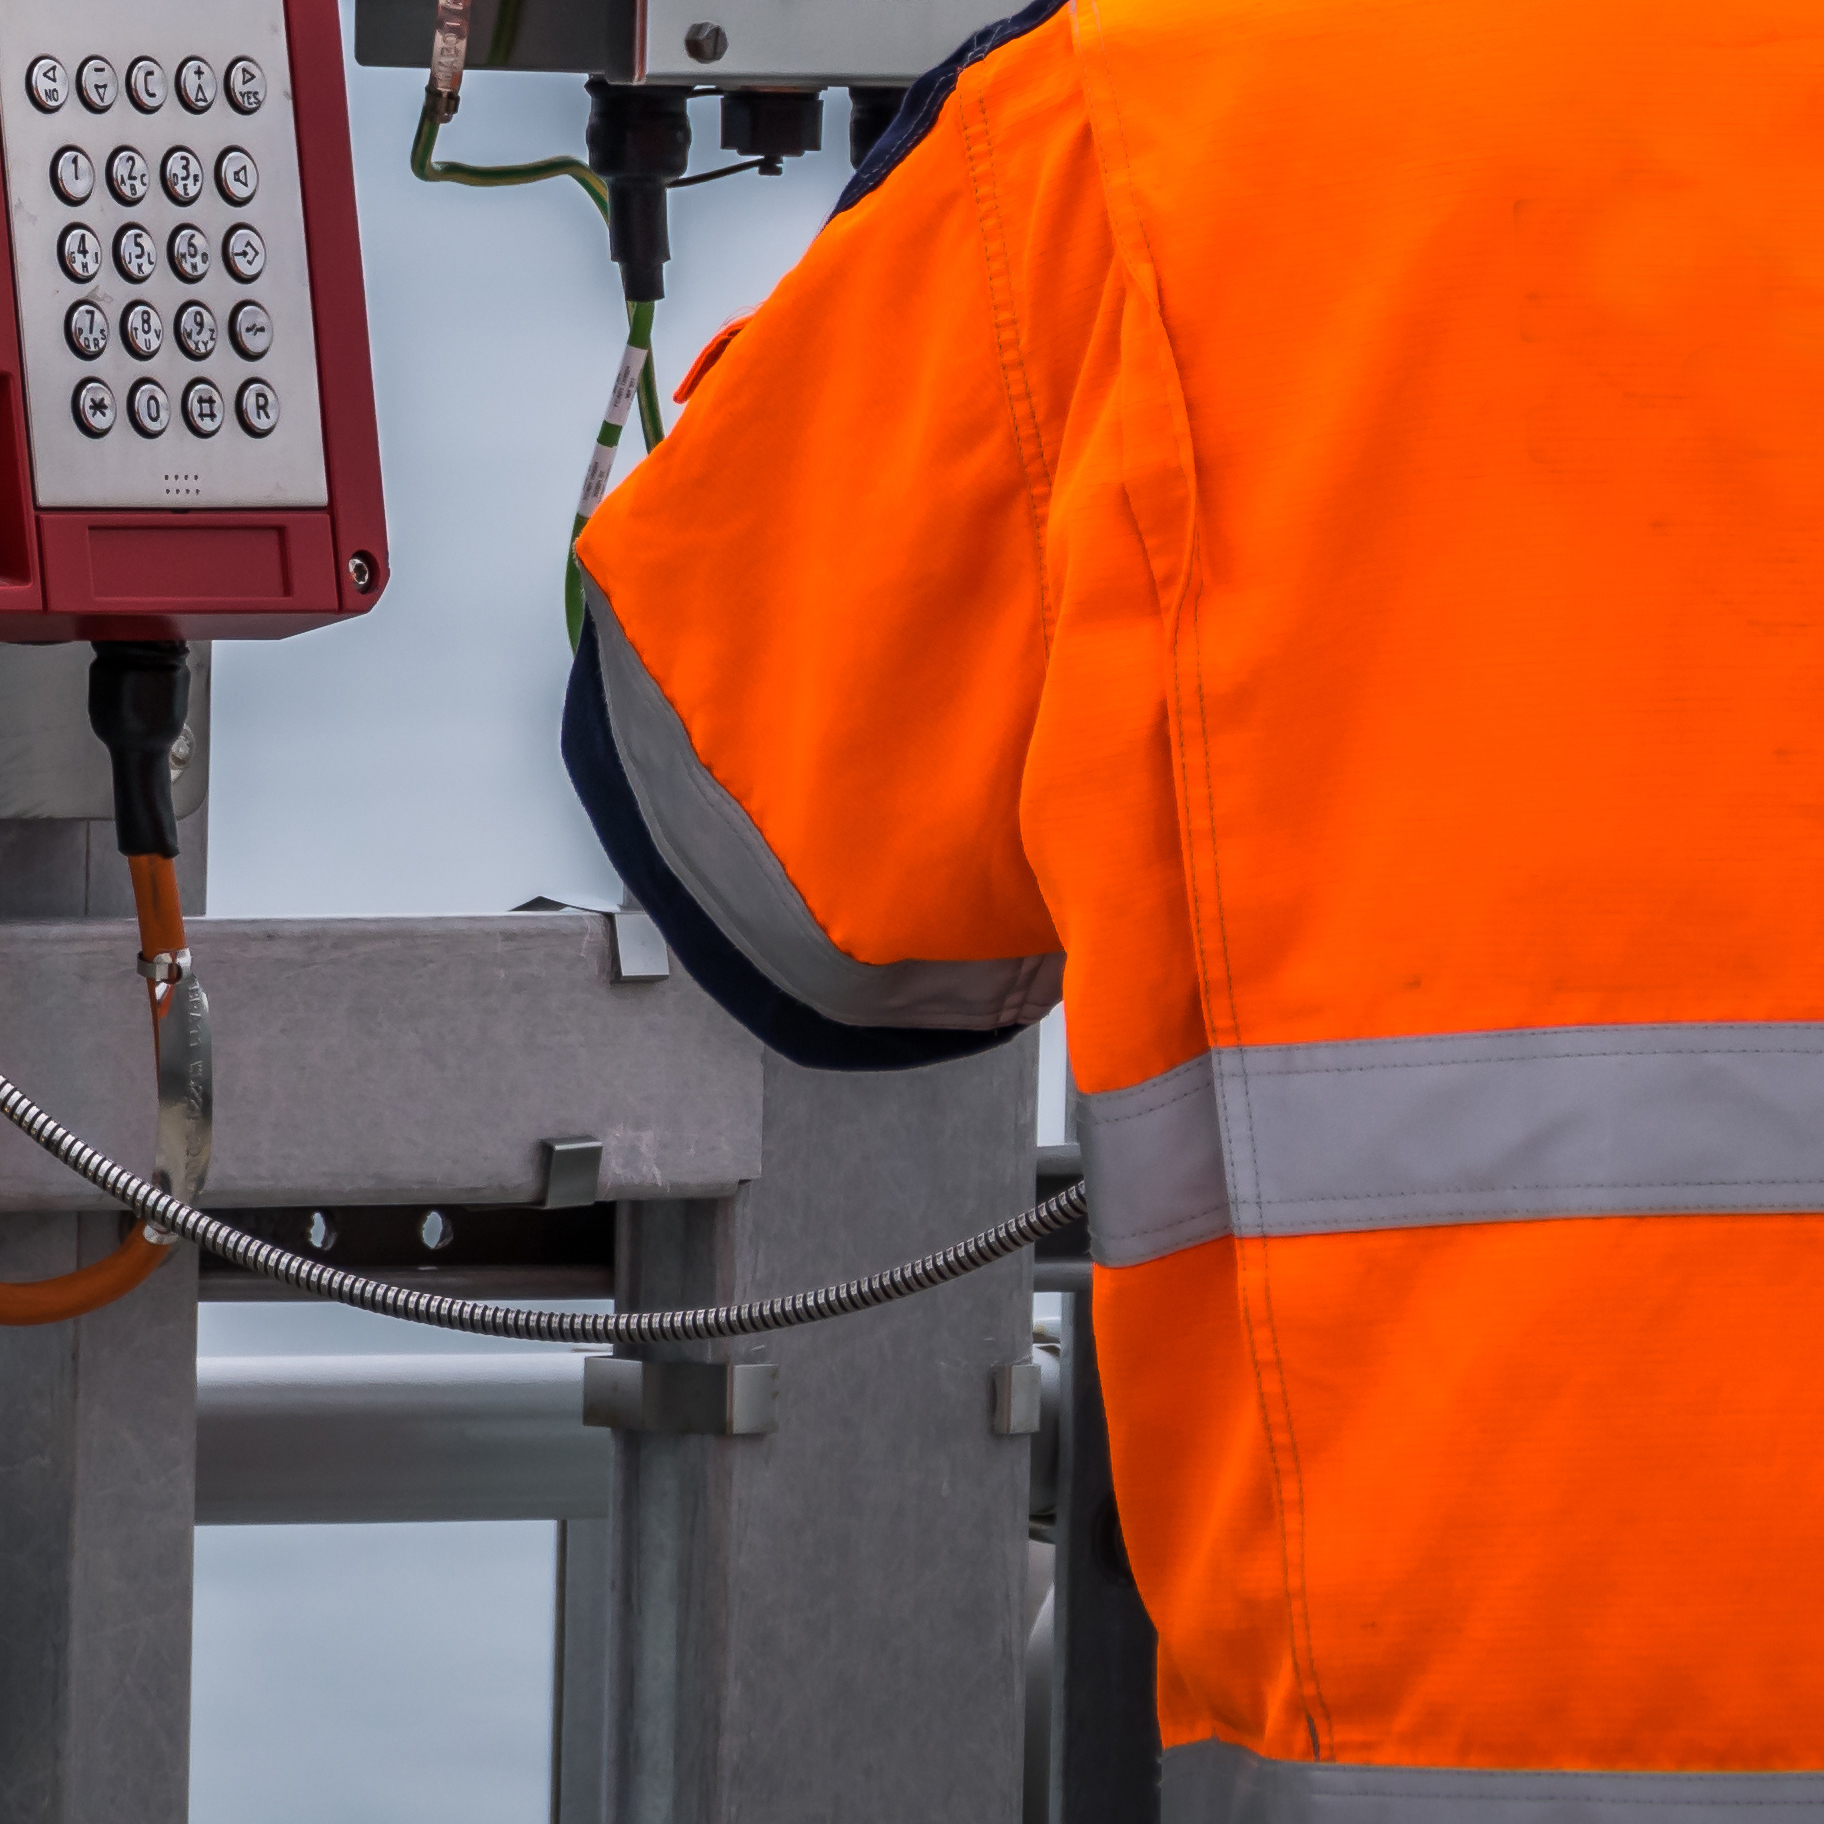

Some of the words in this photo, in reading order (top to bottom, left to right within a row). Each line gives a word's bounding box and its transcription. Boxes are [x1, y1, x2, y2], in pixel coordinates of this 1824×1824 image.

[44, 88, 59, 103] NO
[239, 90, 260, 106] YES
[71, 154, 79, 181] 1
[126, 155, 138, 181] 2
[179, 155, 191, 181] 3
[77, 233, 89, 259] 4
[133, 233, 145, 259] 5
[187, 233, 198, 259] 6
[85, 309, 95, 335] 7
[141, 309, 152, 335] 8
[193, 310, 204, 336] 9
[255, 392, 271, 420] R
